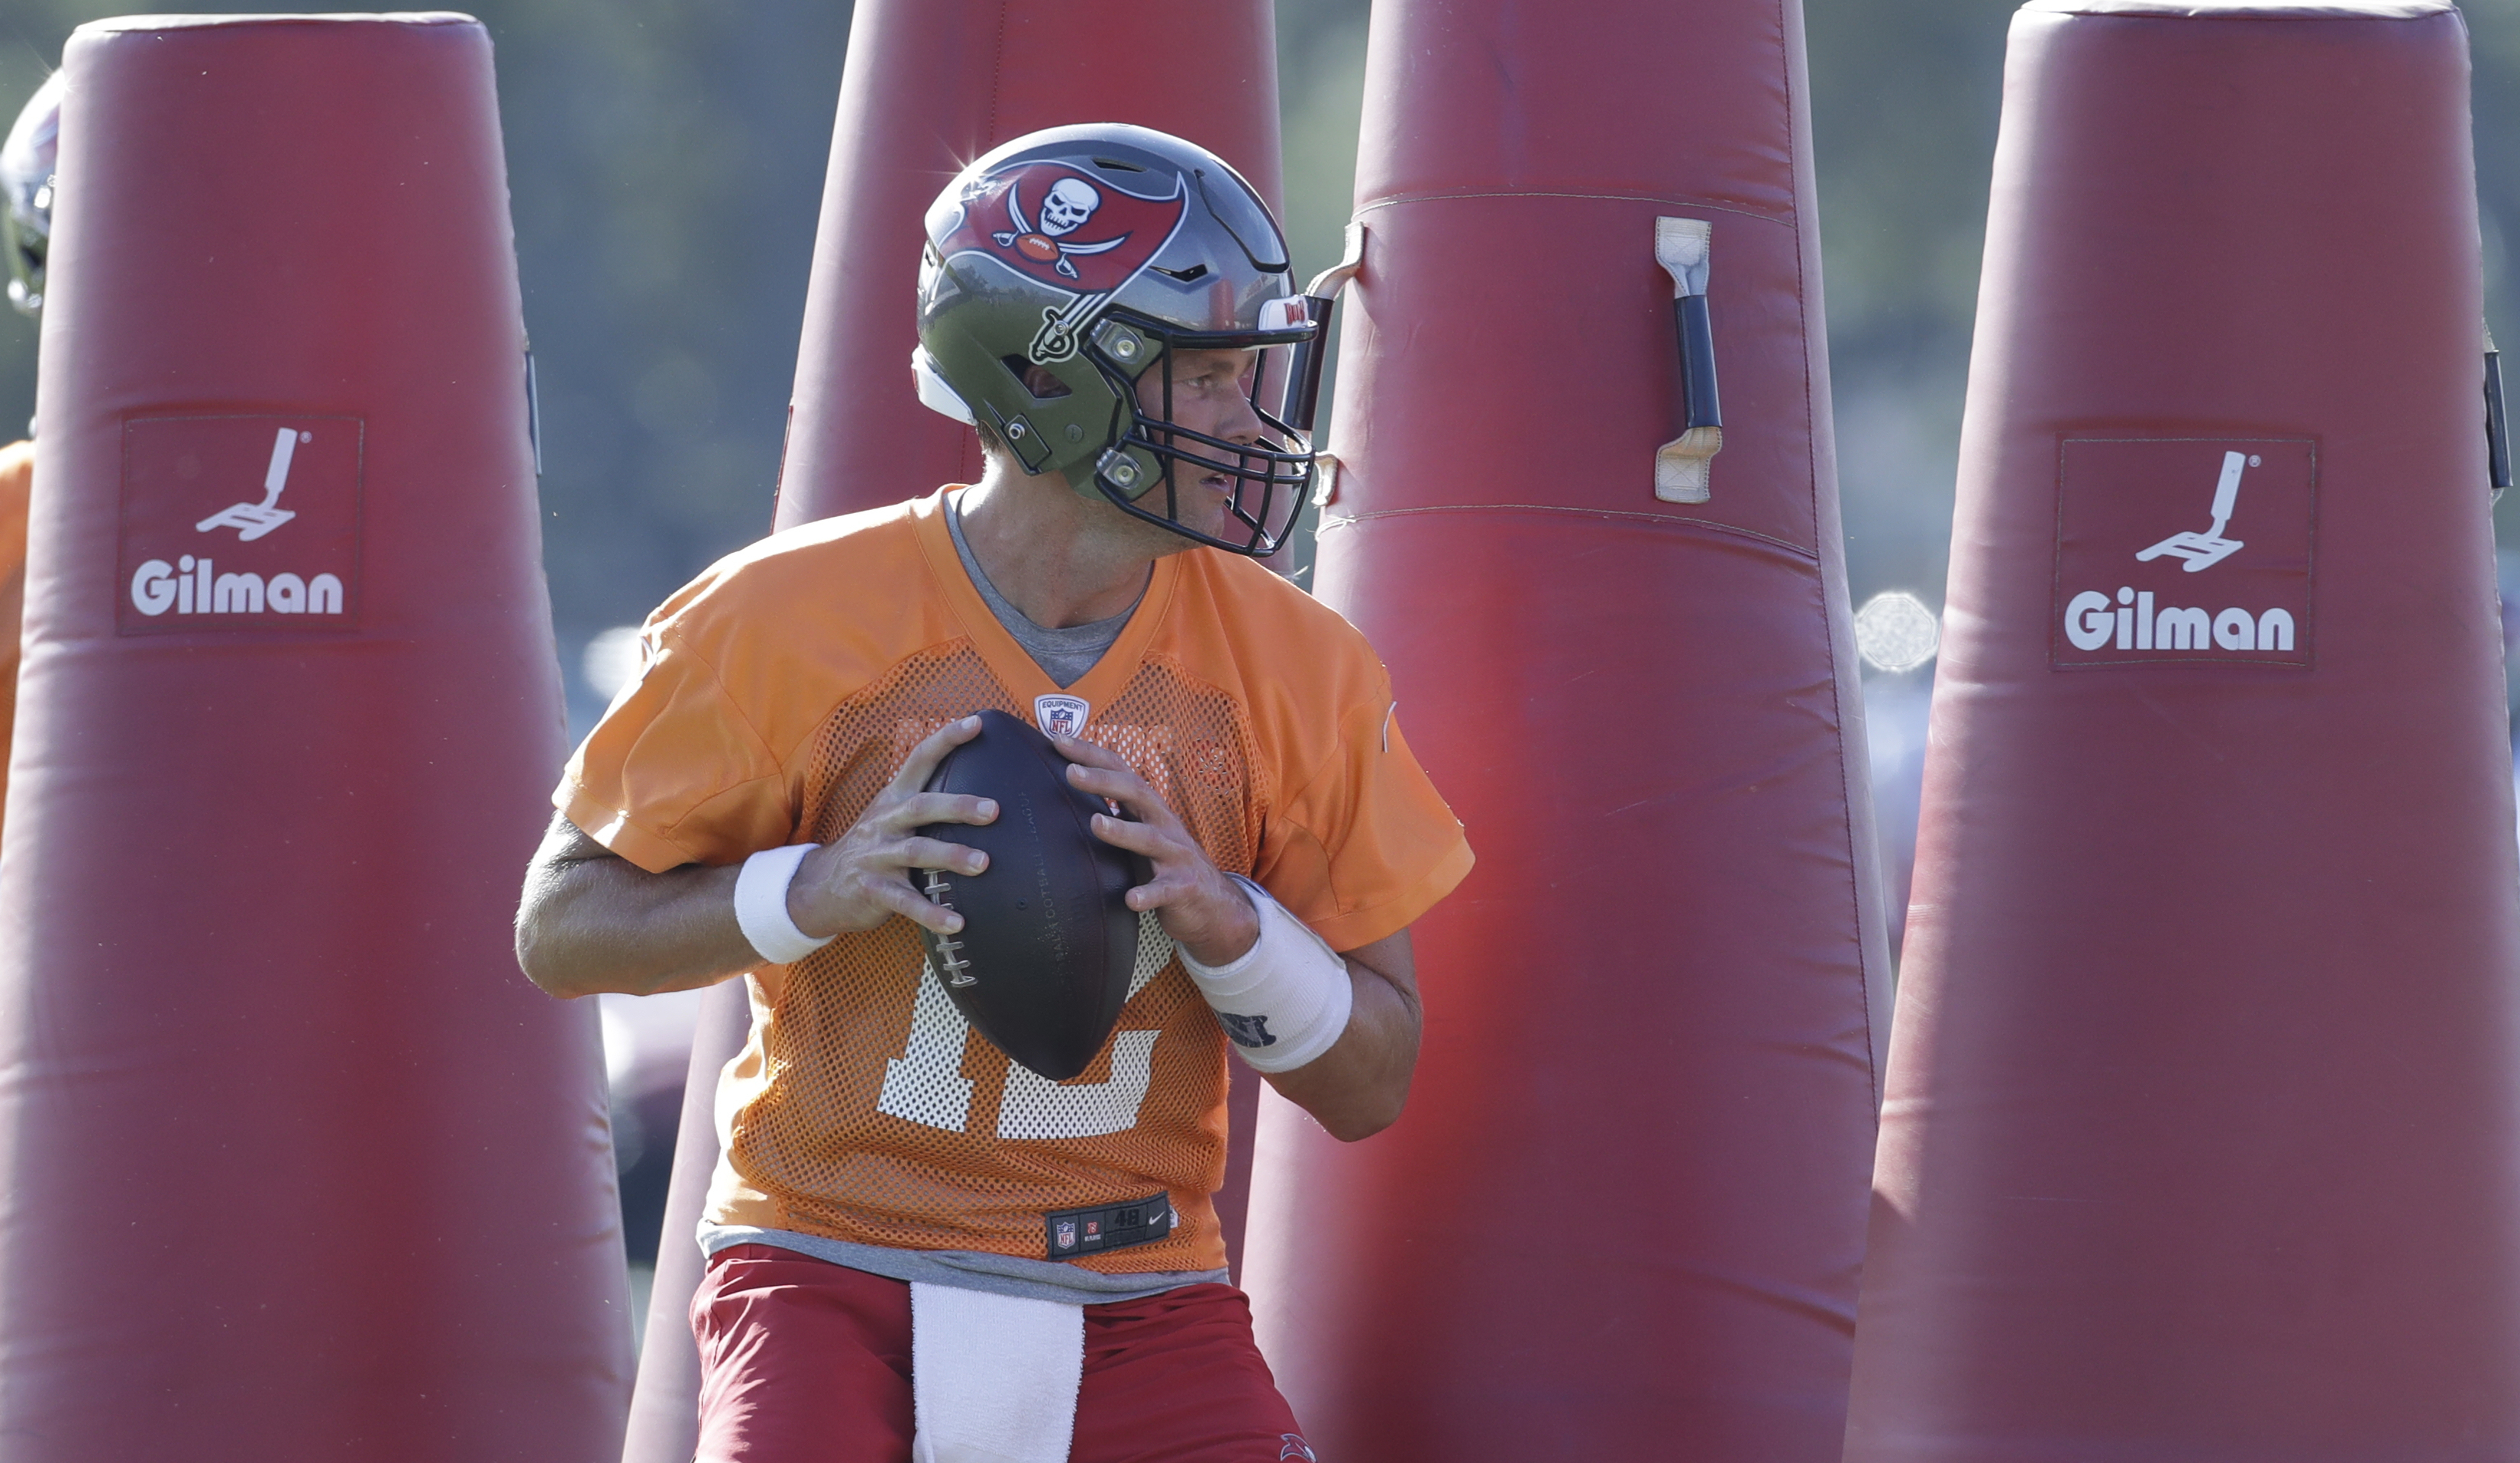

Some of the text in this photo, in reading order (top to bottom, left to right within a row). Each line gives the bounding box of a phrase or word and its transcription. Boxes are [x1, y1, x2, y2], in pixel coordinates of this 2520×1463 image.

[131, 554, 343, 615] Gilman
[2065, 586, 2294, 651] Gilman
[1042, 700, 1083, 712] EQUIPMENT
[1051, 719, 1071, 733] NFL
[1059, 1232, 1074, 1244] NFL
